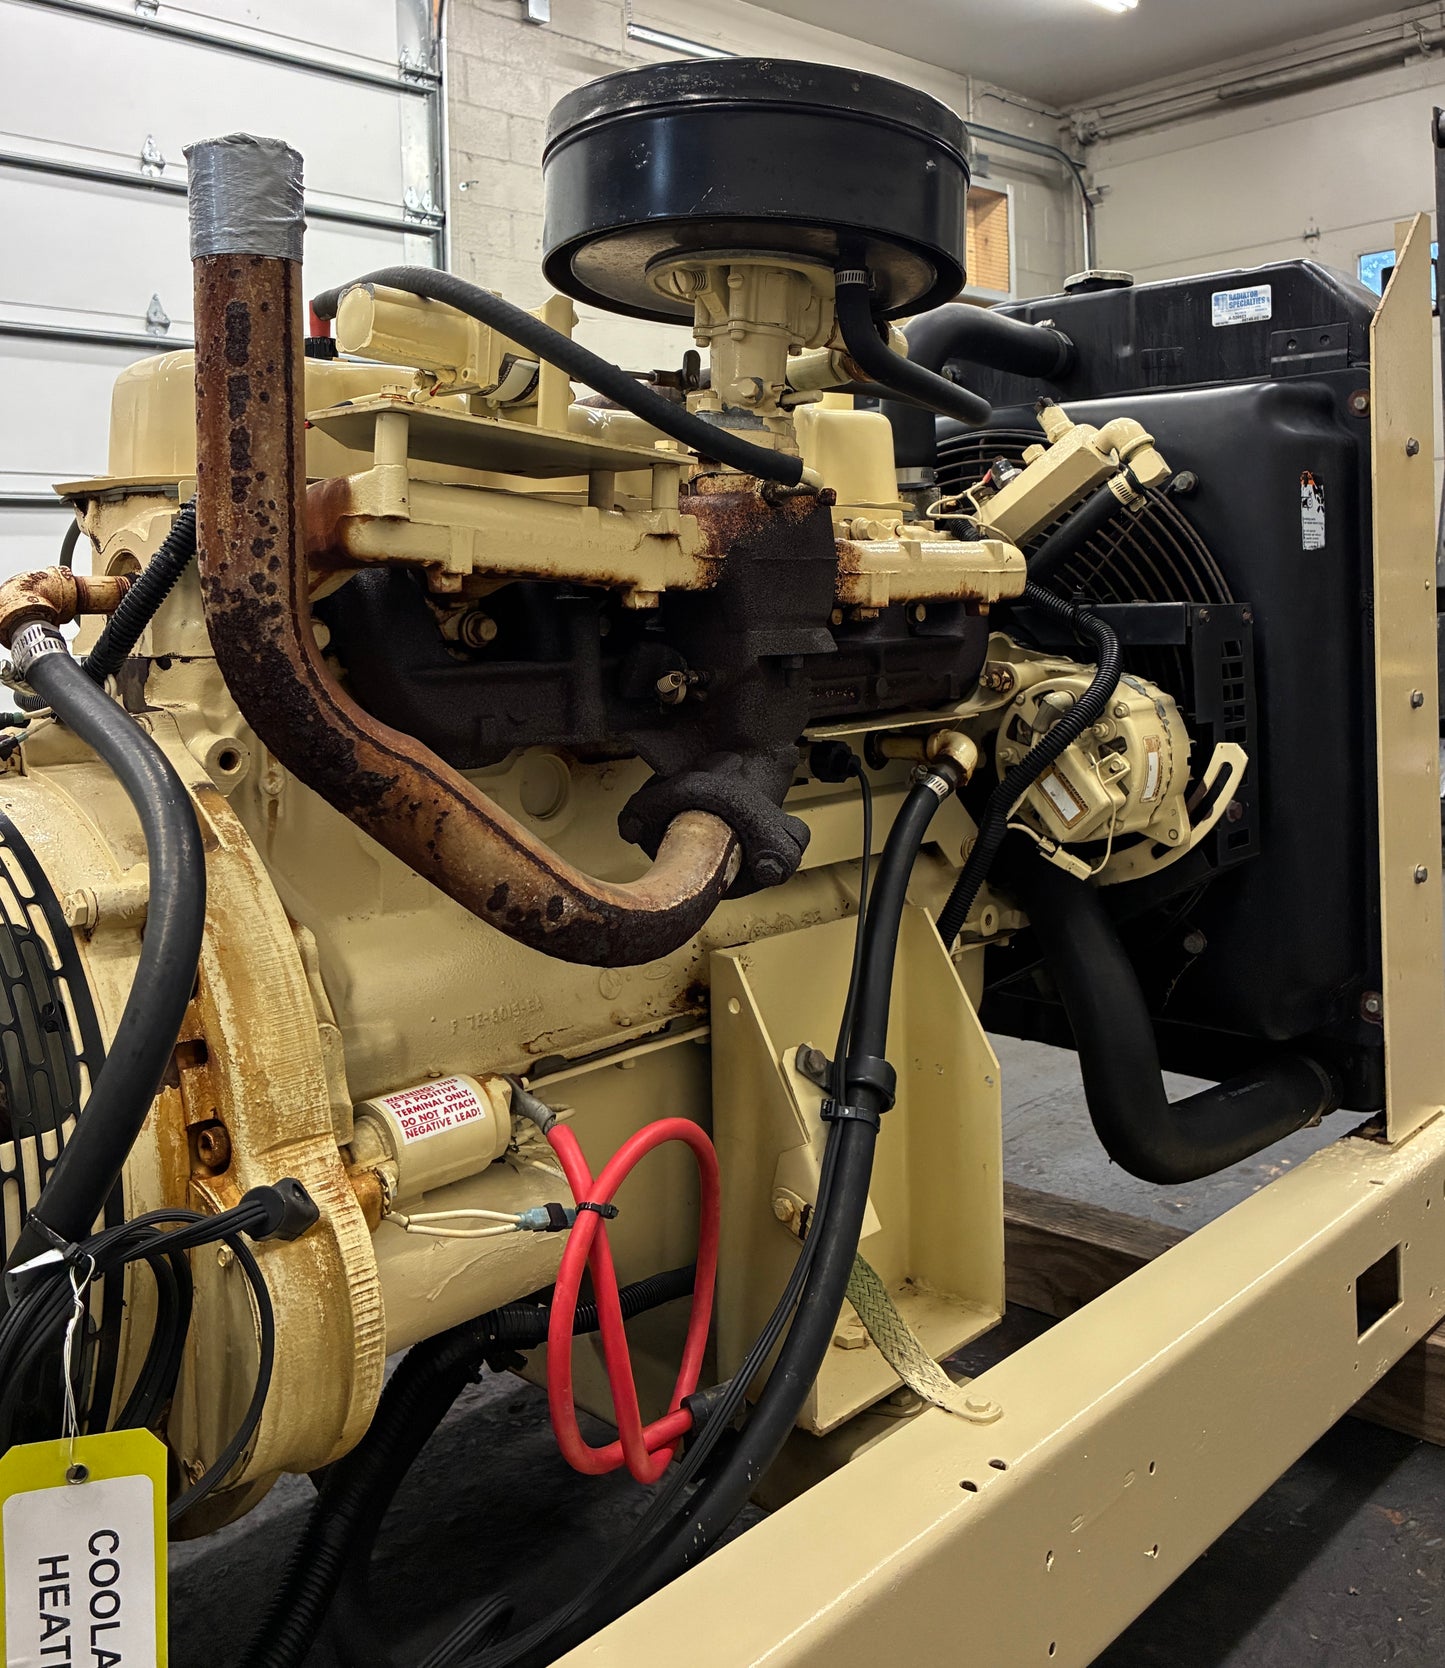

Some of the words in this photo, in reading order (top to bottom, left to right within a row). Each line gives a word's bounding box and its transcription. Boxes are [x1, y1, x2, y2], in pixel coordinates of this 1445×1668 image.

[1228, 296, 1266, 309] SPECIALTIES
[1229, 290, 1258, 301] RADIATOR
[383, 1085, 435, 1104] WARNING!
[436, 1078, 458, 1088] THIS
[390, 1102, 401, 1110] IS
[413, 1085, 458, 1103] POSITIVE
[395, 1098, 445, 1118] TERMINAL
[445, 1089, 472, 1102] ONLY.
[401, 1118, 417, 1129] DO
[418, 1109, 441, 1122] NOT
[443, 1097, 477, 1115] ATTACH
[405, 1117, 452, 1139] NEGATIVE
[455, 1107, 481, 1123] LEAD!
[37, 1554, 72, 1668] HEAT
